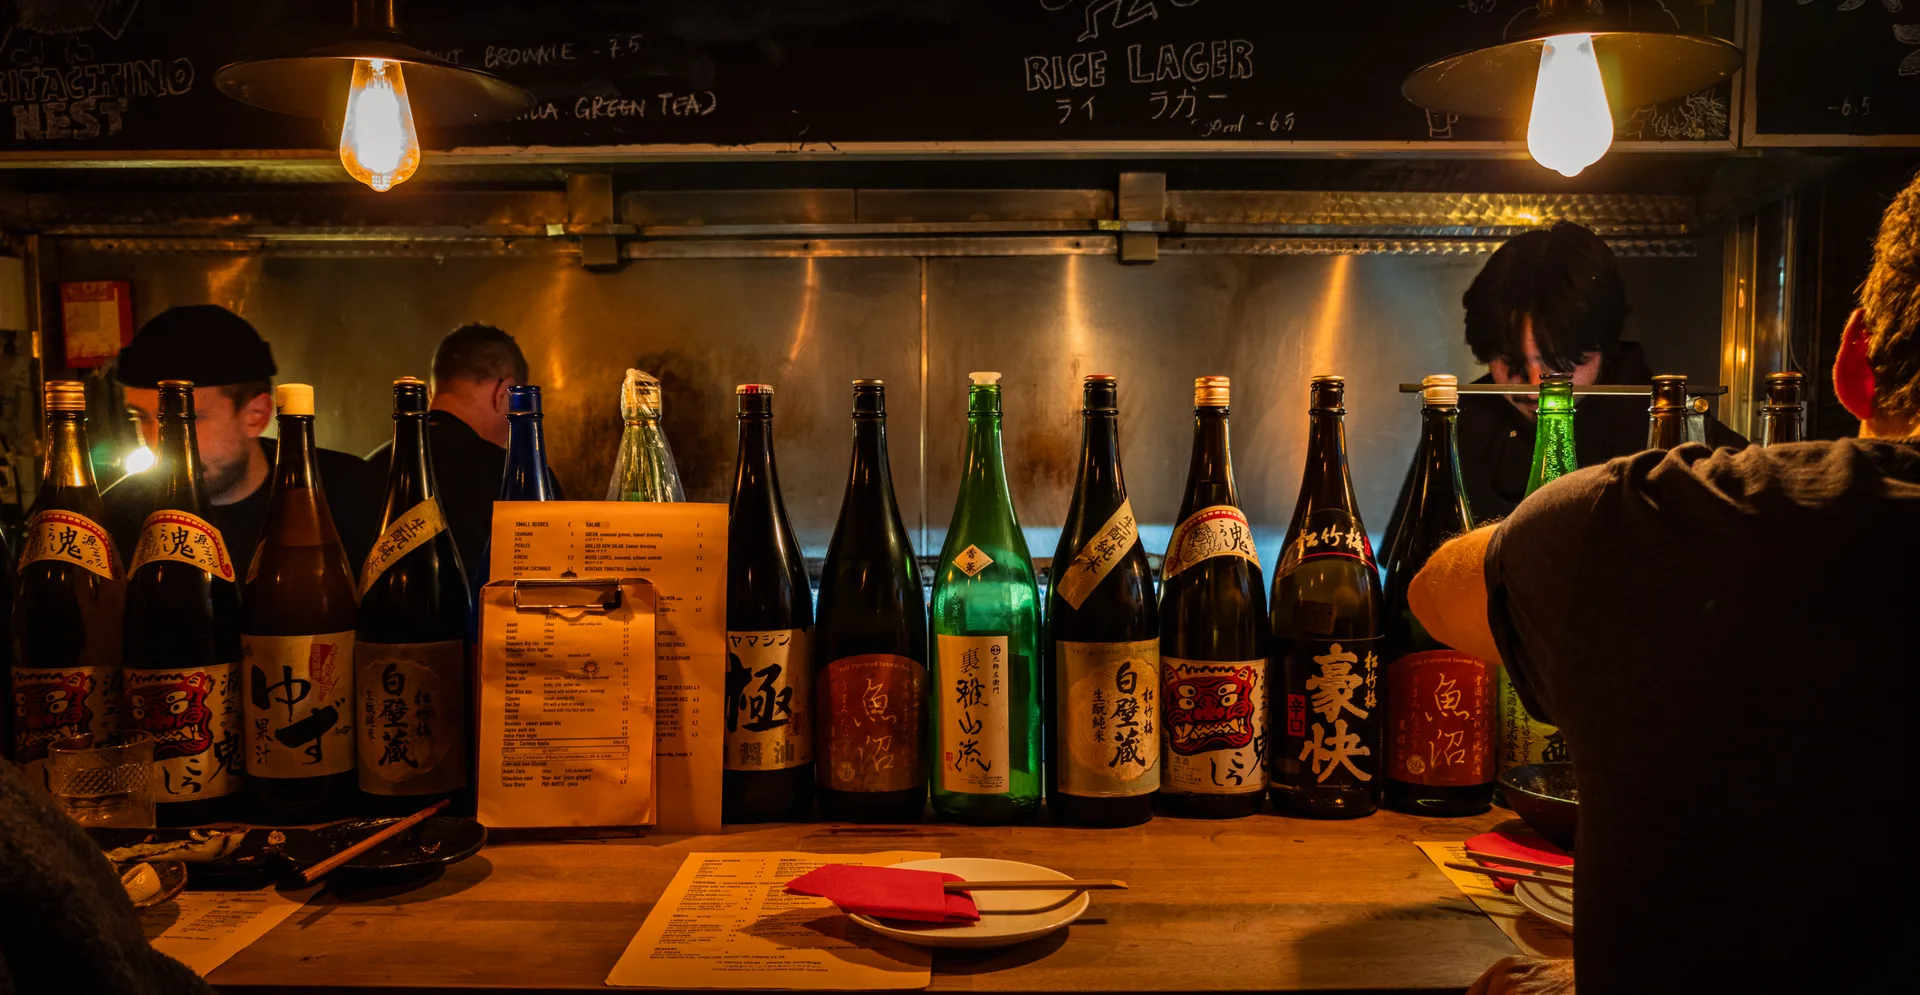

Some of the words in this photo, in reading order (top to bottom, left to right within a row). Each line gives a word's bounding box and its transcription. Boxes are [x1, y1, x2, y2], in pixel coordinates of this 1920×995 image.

[484, 43, 578, 70] BROWNIE
[1025, 51, 1107, 92] RICE
[1127, 40, 1254, 84] LAGER
[12, 99, 128, 141] NEST
[573, 95, 645, 121] GREEN
[1055, 96, 1097, 125] ライ
[1149, 87, 1229, 121] ラガー
[55, 525, 83, 560] 鬼
[167, 525, 196, 560] 鬼
[1081, 514, 1132, 576] 生酛純米
[1229, 521, 1250, 556] 鬼
[1295, 526, 1363, 551] 松竹梅
[729, 634, 790, 649] ヤマシン
[724, 650, 794, 735] 極
[1363, 650, 1378, 710] 松竹梅
[251, 664, 346, 768] ゆず
[376, 662, 420, 769] 白壁蔵
[852, 677, 898, 774] 魚沼
[1091, 688, 1107, 743] 生酛純米
[1108, 661, 1145, 768] 白壁蔵
[1140, 685, 1154, 736] 松竹梅
[1290, 698, 1302, 735] 辛口
[1298, 641, 1373, 784] 豪快
[1424, 672, 1471, 769] 魚沼
[254, 716, 272, 766] 果汁
